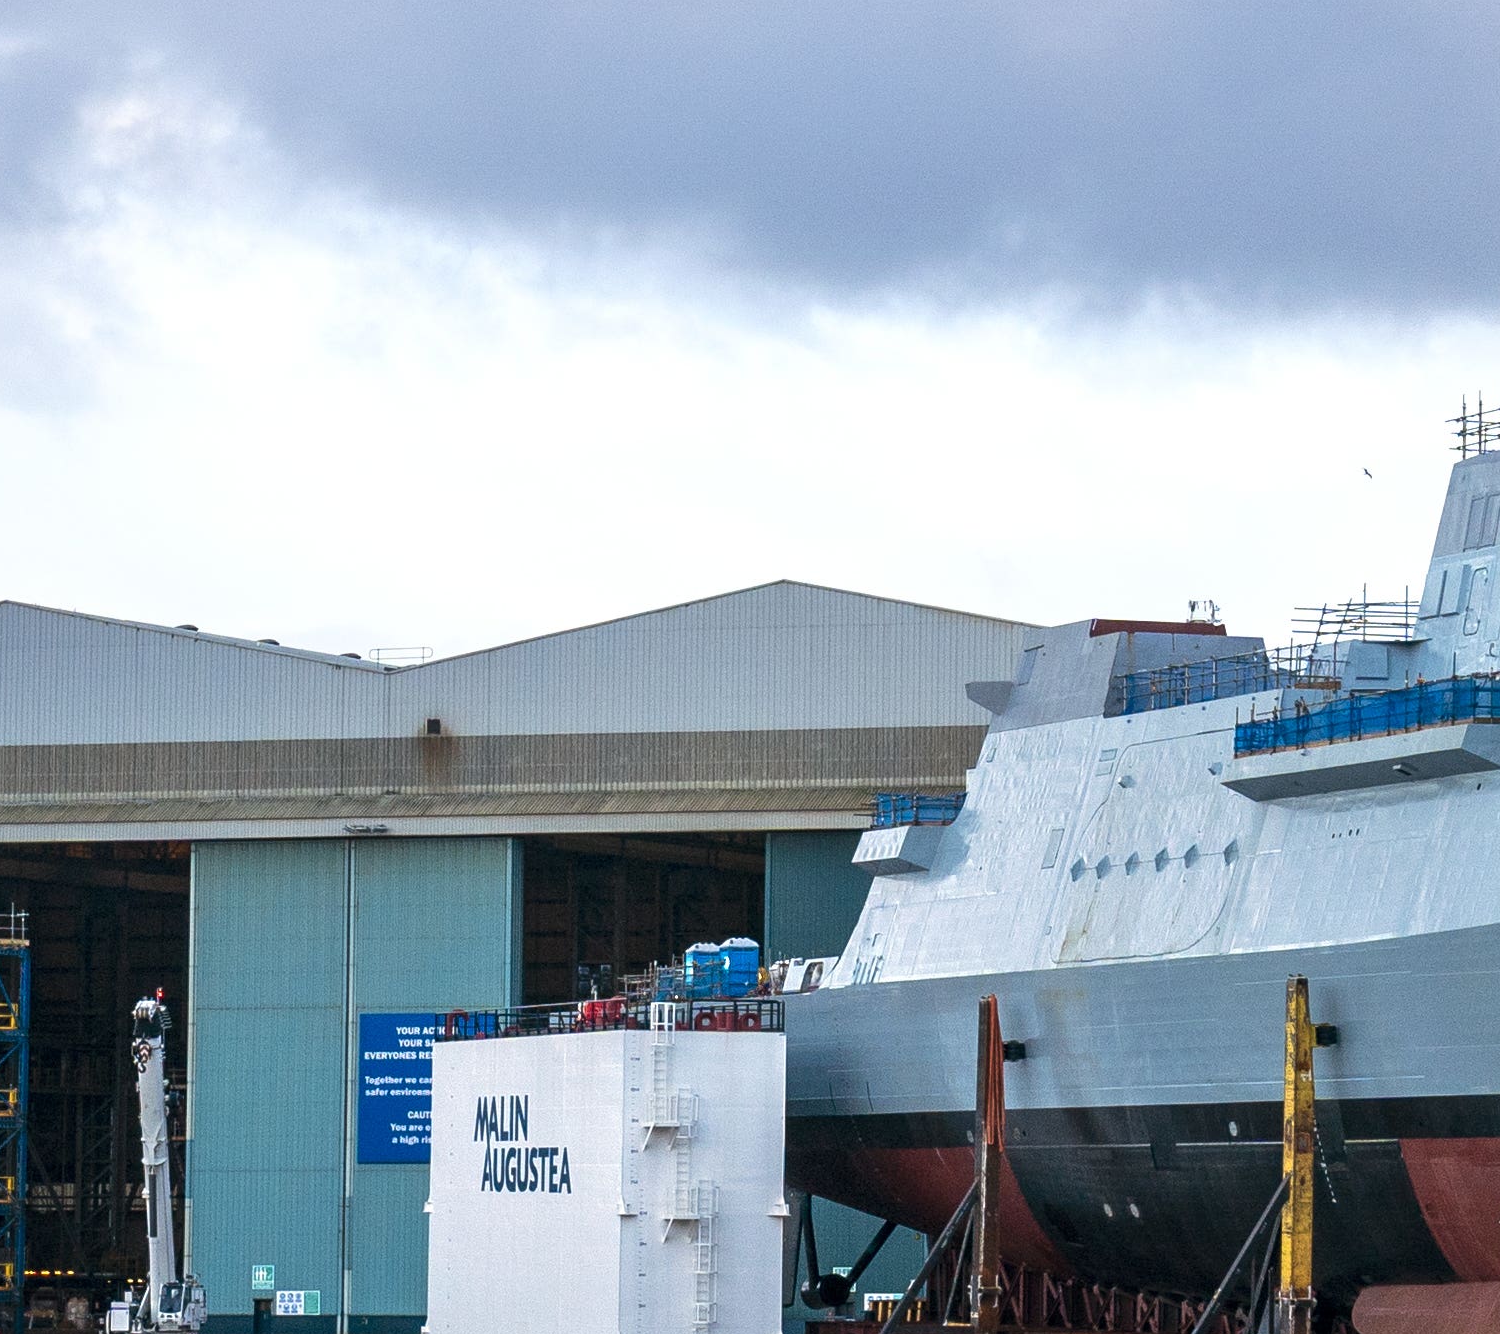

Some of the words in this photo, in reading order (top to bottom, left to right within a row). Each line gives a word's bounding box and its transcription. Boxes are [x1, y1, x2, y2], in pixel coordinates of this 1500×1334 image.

[396, 1026, 420, 1035] YOUR
[398, 1038, 423, 1047] YOUR
[364, 1052, 417, 1060] EVERYONES
[365, 1076, 403, 1086] Together
[365, 1088, 388, 1096] safer
[474, 1094, 528, 1142] MALIN
[390, 1123, 406, 1132] You
[399, 1136, 419, 1145] high
[481, 1146, 572, 1194] AUGUSTEA
